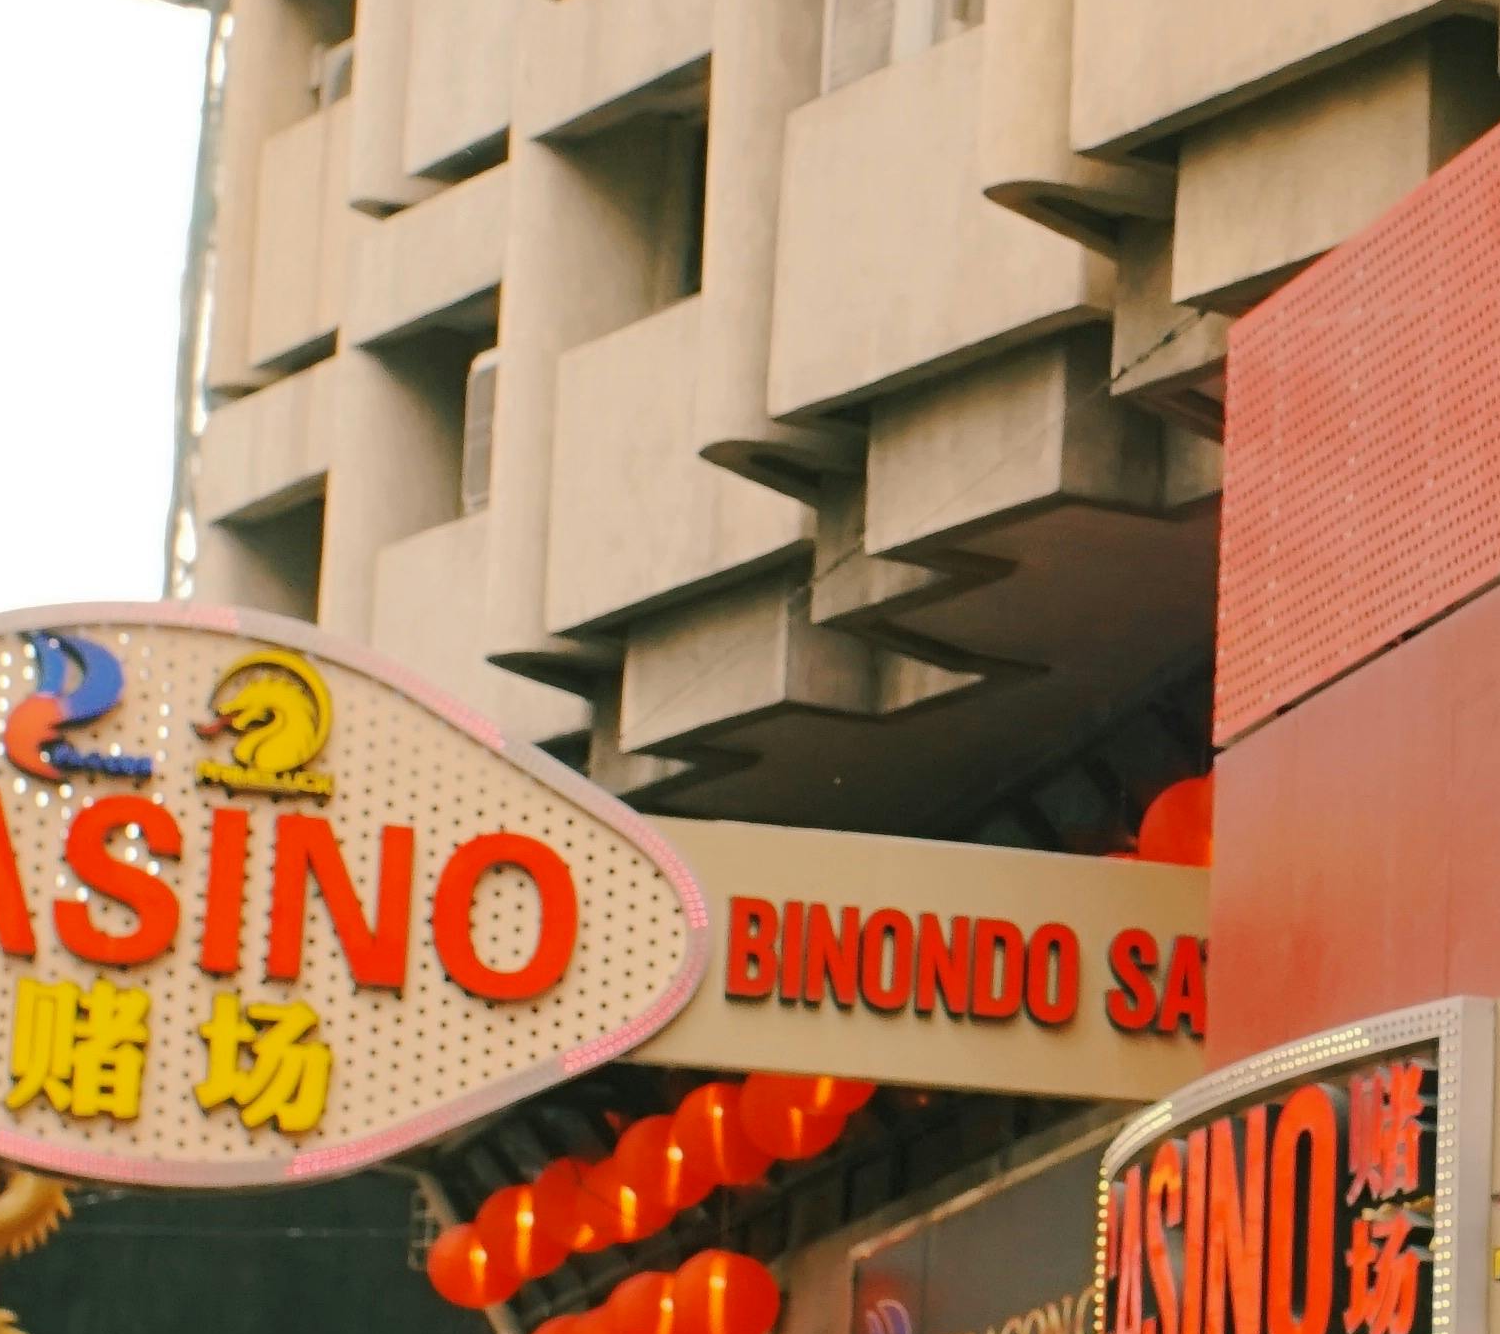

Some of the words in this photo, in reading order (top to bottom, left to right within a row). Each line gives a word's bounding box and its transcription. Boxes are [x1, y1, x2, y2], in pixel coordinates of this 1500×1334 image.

[726, 896, 1079, 1025] BINONDO
[1105, 926, 1208, 1039] SA
[4, 978, 333, 1133] 赌场
